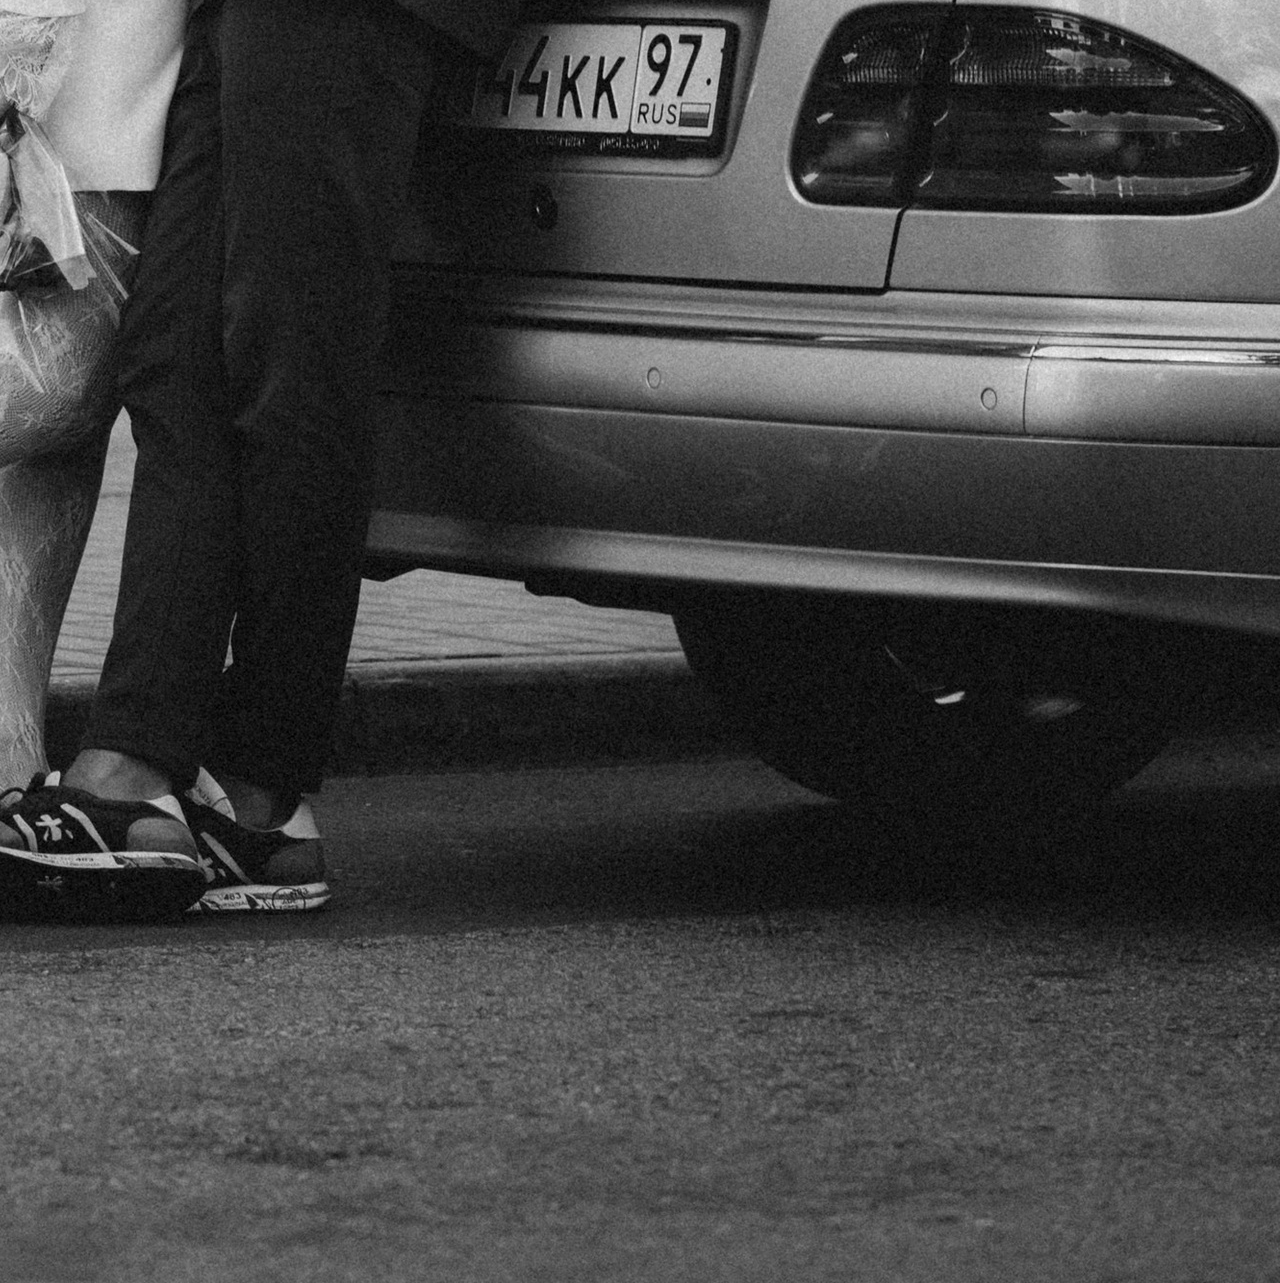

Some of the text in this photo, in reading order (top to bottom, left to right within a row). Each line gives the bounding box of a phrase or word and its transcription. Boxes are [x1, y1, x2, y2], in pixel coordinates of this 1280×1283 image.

[474, 33, 703, 118] 44KK 97
[637, 102, 678, 125] RUS
